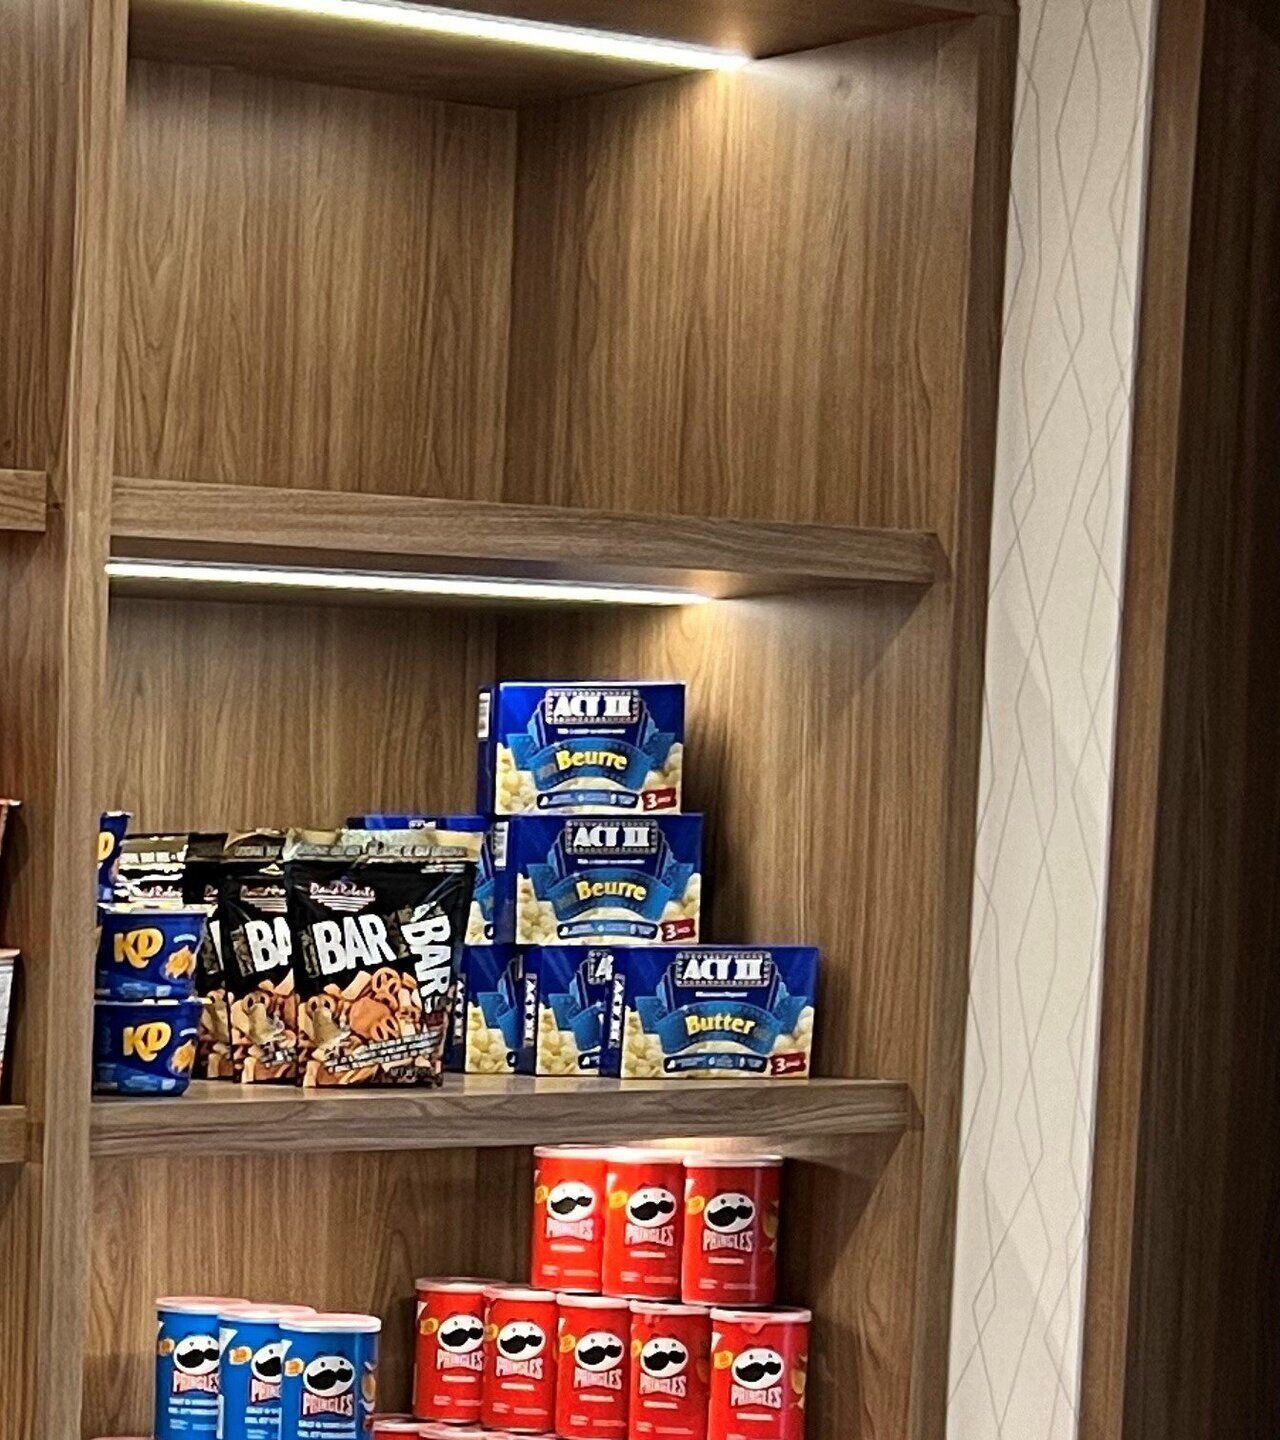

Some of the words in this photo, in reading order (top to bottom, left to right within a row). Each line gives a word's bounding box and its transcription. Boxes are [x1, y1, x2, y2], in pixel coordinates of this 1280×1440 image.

[555, 750, 628, 772] Beurre
[646, 792, 657, 809] 3
[576, 880, 648, 901] Beurre
[665, 923, 677, 940] 3
[313, 912, 397, 976] BAR
[401, 913, 453, 997] BAR
[684, 1014, 756, 1036] Butter
[774, 1057, 786, 1073] 3
[301, 1391, 355, 1417] PRINGLES
